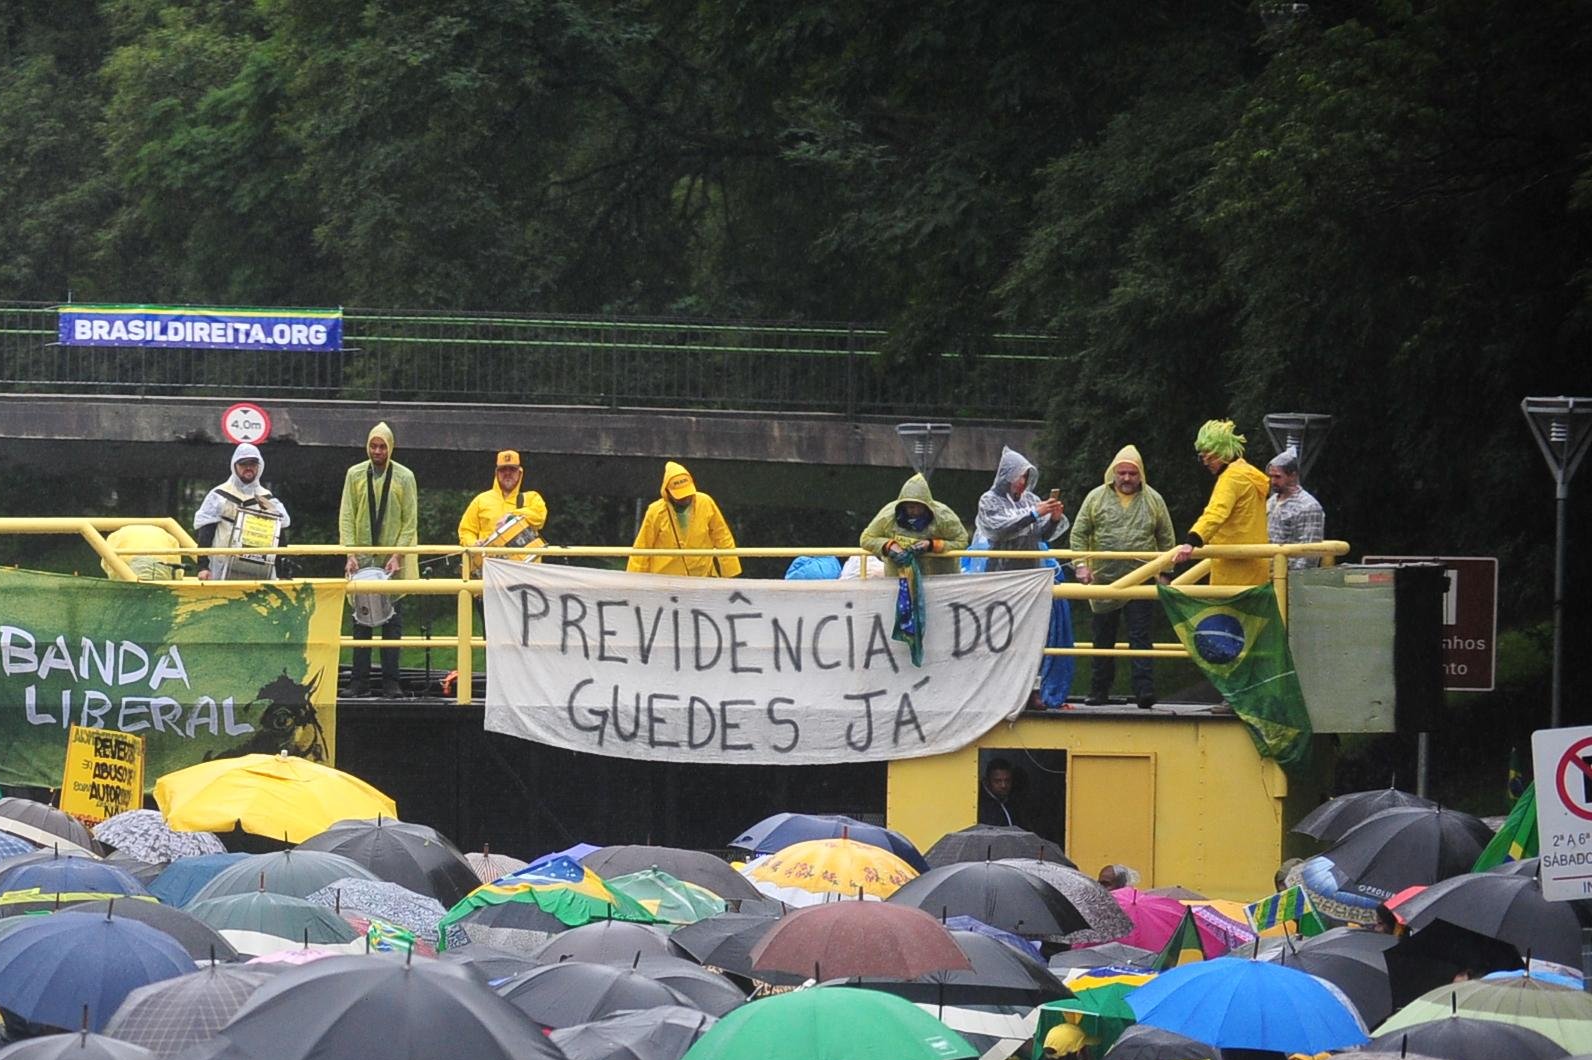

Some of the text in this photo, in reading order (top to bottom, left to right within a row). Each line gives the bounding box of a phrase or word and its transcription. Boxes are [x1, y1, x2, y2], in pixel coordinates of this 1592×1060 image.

[74, 319, 328, 345] BRASILDIREITA.ORG
[0, 625, 191, 690] BANDA
[507, 583, 1014, 675] PREVIDÊNCIA DO
[25, 684, 255, 738] LIBERAL
[567, 675, 930, 753] GUEDES JÁ
[1567, 833, 1576, 847] A
